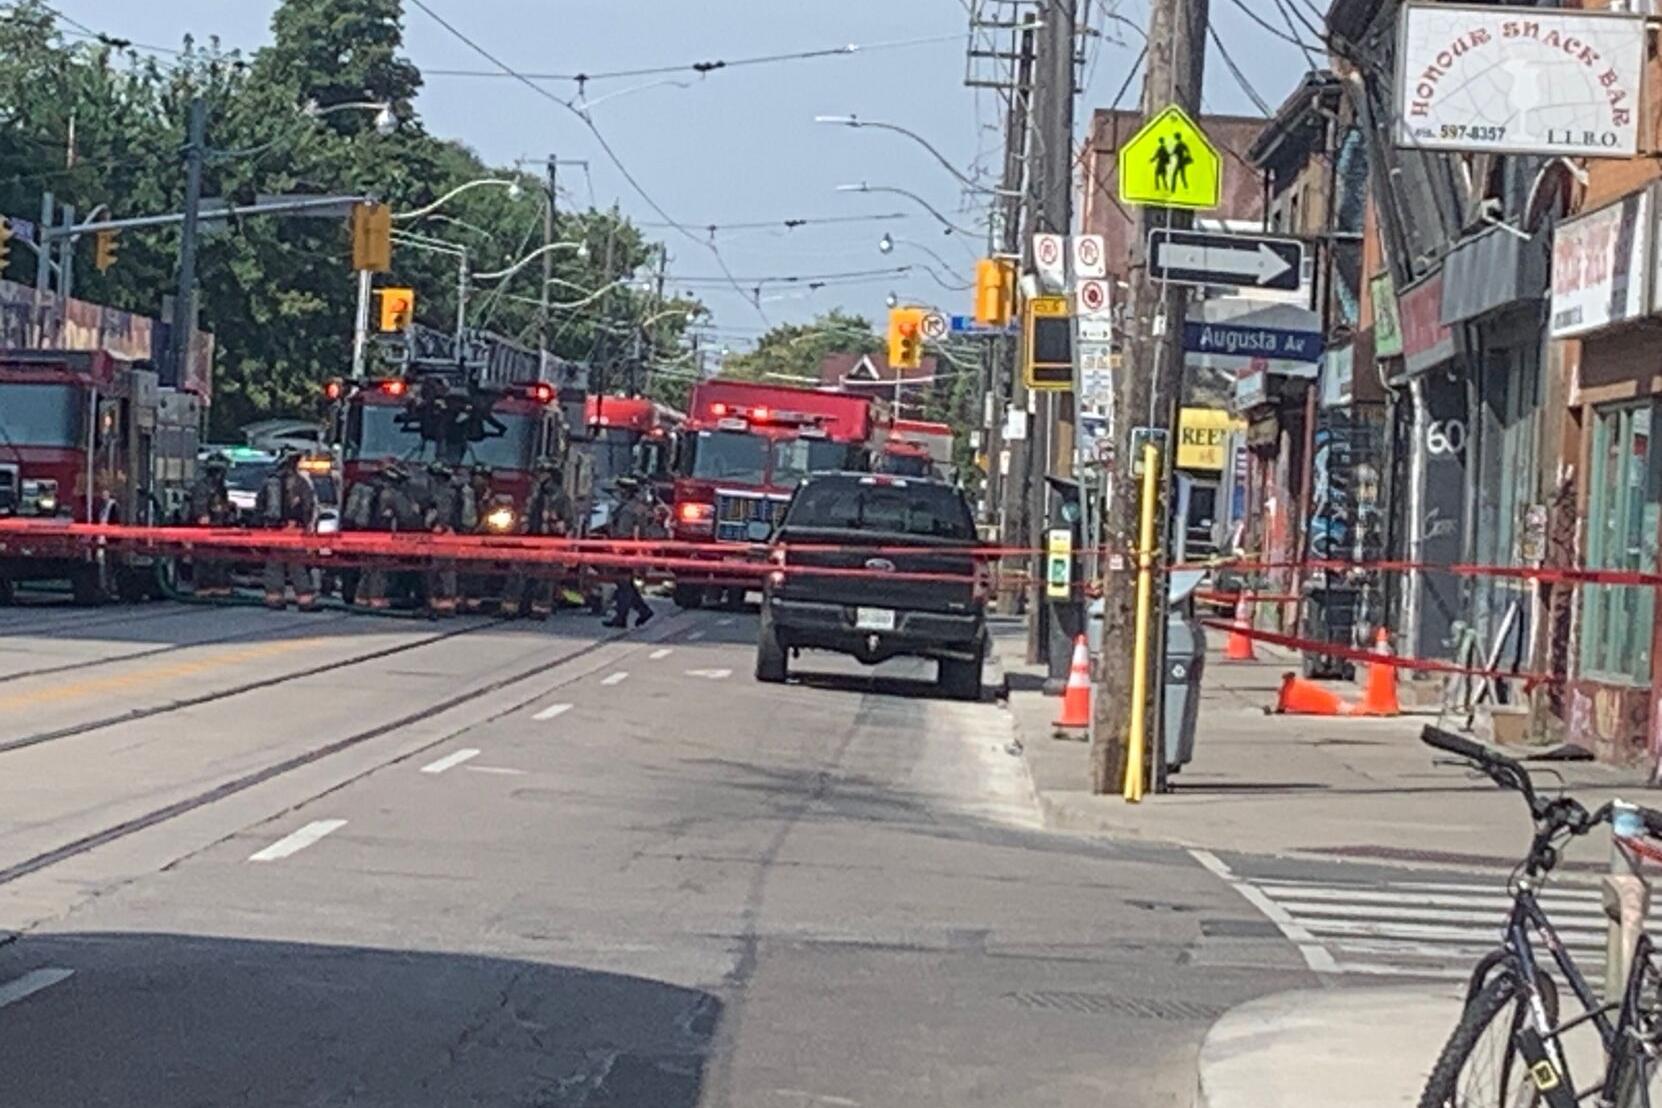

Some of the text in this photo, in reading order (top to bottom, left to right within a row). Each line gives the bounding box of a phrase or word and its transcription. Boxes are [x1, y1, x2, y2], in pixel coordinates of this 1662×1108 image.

[1411, 21, 1630, 127] HONOUR SNACK BAR
[1440, 124, 1506, 142] 597-8357
[1200, 326, 1278, 351] Augusta
[1426, 420, 1465, 454] 60
